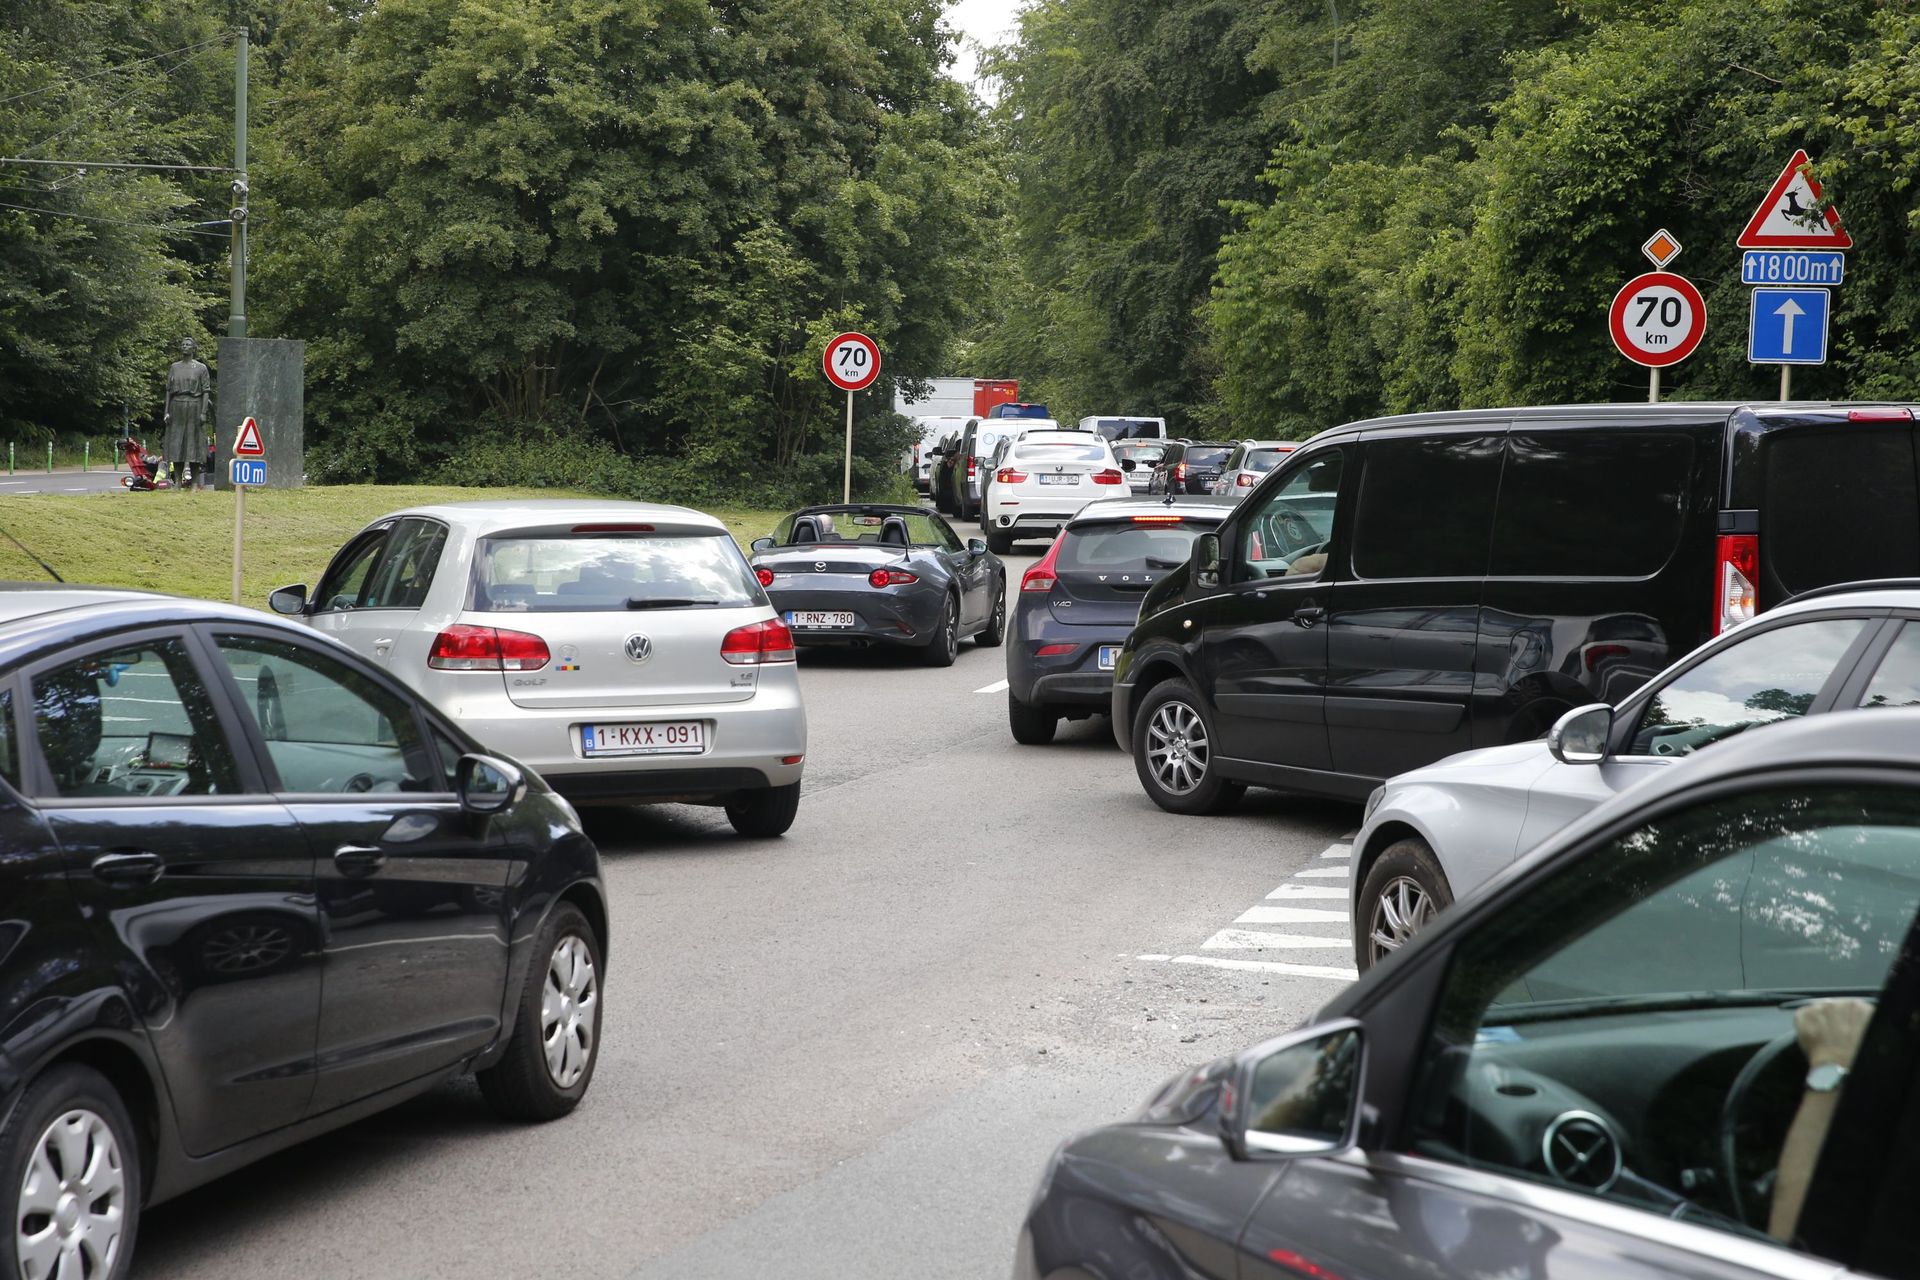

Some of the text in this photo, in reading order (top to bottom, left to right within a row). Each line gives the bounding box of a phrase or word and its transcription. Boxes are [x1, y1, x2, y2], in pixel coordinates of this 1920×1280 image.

[1759, 255, 1828, 281] 1800m
[1636, 297, 1682, 327] 70
[1645, 331, 1668, 344] km
[839, 347, 867, 367] 70
[844, 369, 859, 377] km
[235, 462, 264, 483] 10 m
[794, 613, 853, 624] 1-RNZ-780
[513, 678, 547, 687] GOLF
[585, 725, 699, 748] B 1-KXX-091
